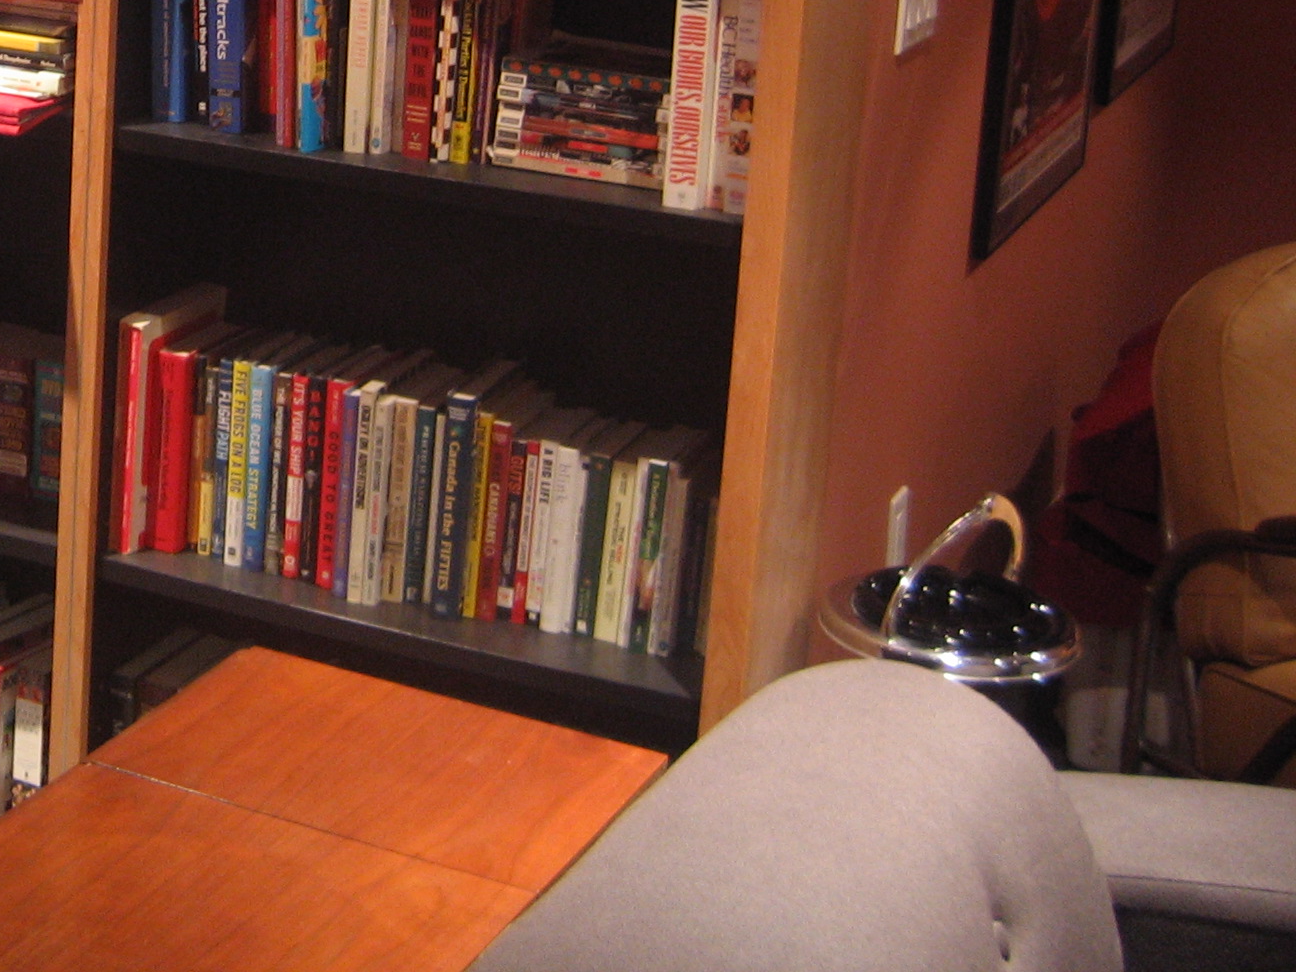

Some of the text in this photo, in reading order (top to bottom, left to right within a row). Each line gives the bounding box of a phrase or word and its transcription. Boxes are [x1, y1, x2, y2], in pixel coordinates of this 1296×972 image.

[198, 12, 208, 26] be
[678, 15, 708, 47] OUR
[722, 15, 739, 41] BC
[197, 27, 208, 44] the
[196, 45, 207, 73] place
[460, 36, 472, 68] Parties
[669, 106, 702, 186] OURSELVES
[275, 387, 285, 404] THE
[215, 390, 232, 460] FLIGHT PATH
[230, 370, 247, 493] FIVE FROGS ON A LOG
[273, 405, 285, 436] POWER
[289, 382, 304, 474] IT'S YOUR SHIP
[246, 387, 265, 530] BLUE OCEAN STRATEGY
[272, 449, 282, 465] WE
[273, 437, 283, 448] OF
[359, 437, 369, 451] ON
[355, 452, 369, 509] ADVERTISING
[508, 455, 524, 495] GUTS!
[541, 459, 554, 478] BIG
[322, 431, 339, 562] GOOD TO GREAT
[539, 481, 552, 505] LIFE
[436, 441, 463, 590] Canada in the FIFTIES
[485, 482, 501, 544] CANADIANS
[617, 526, 626, 541] THE
[606, 549, 618, 586] SELLING
